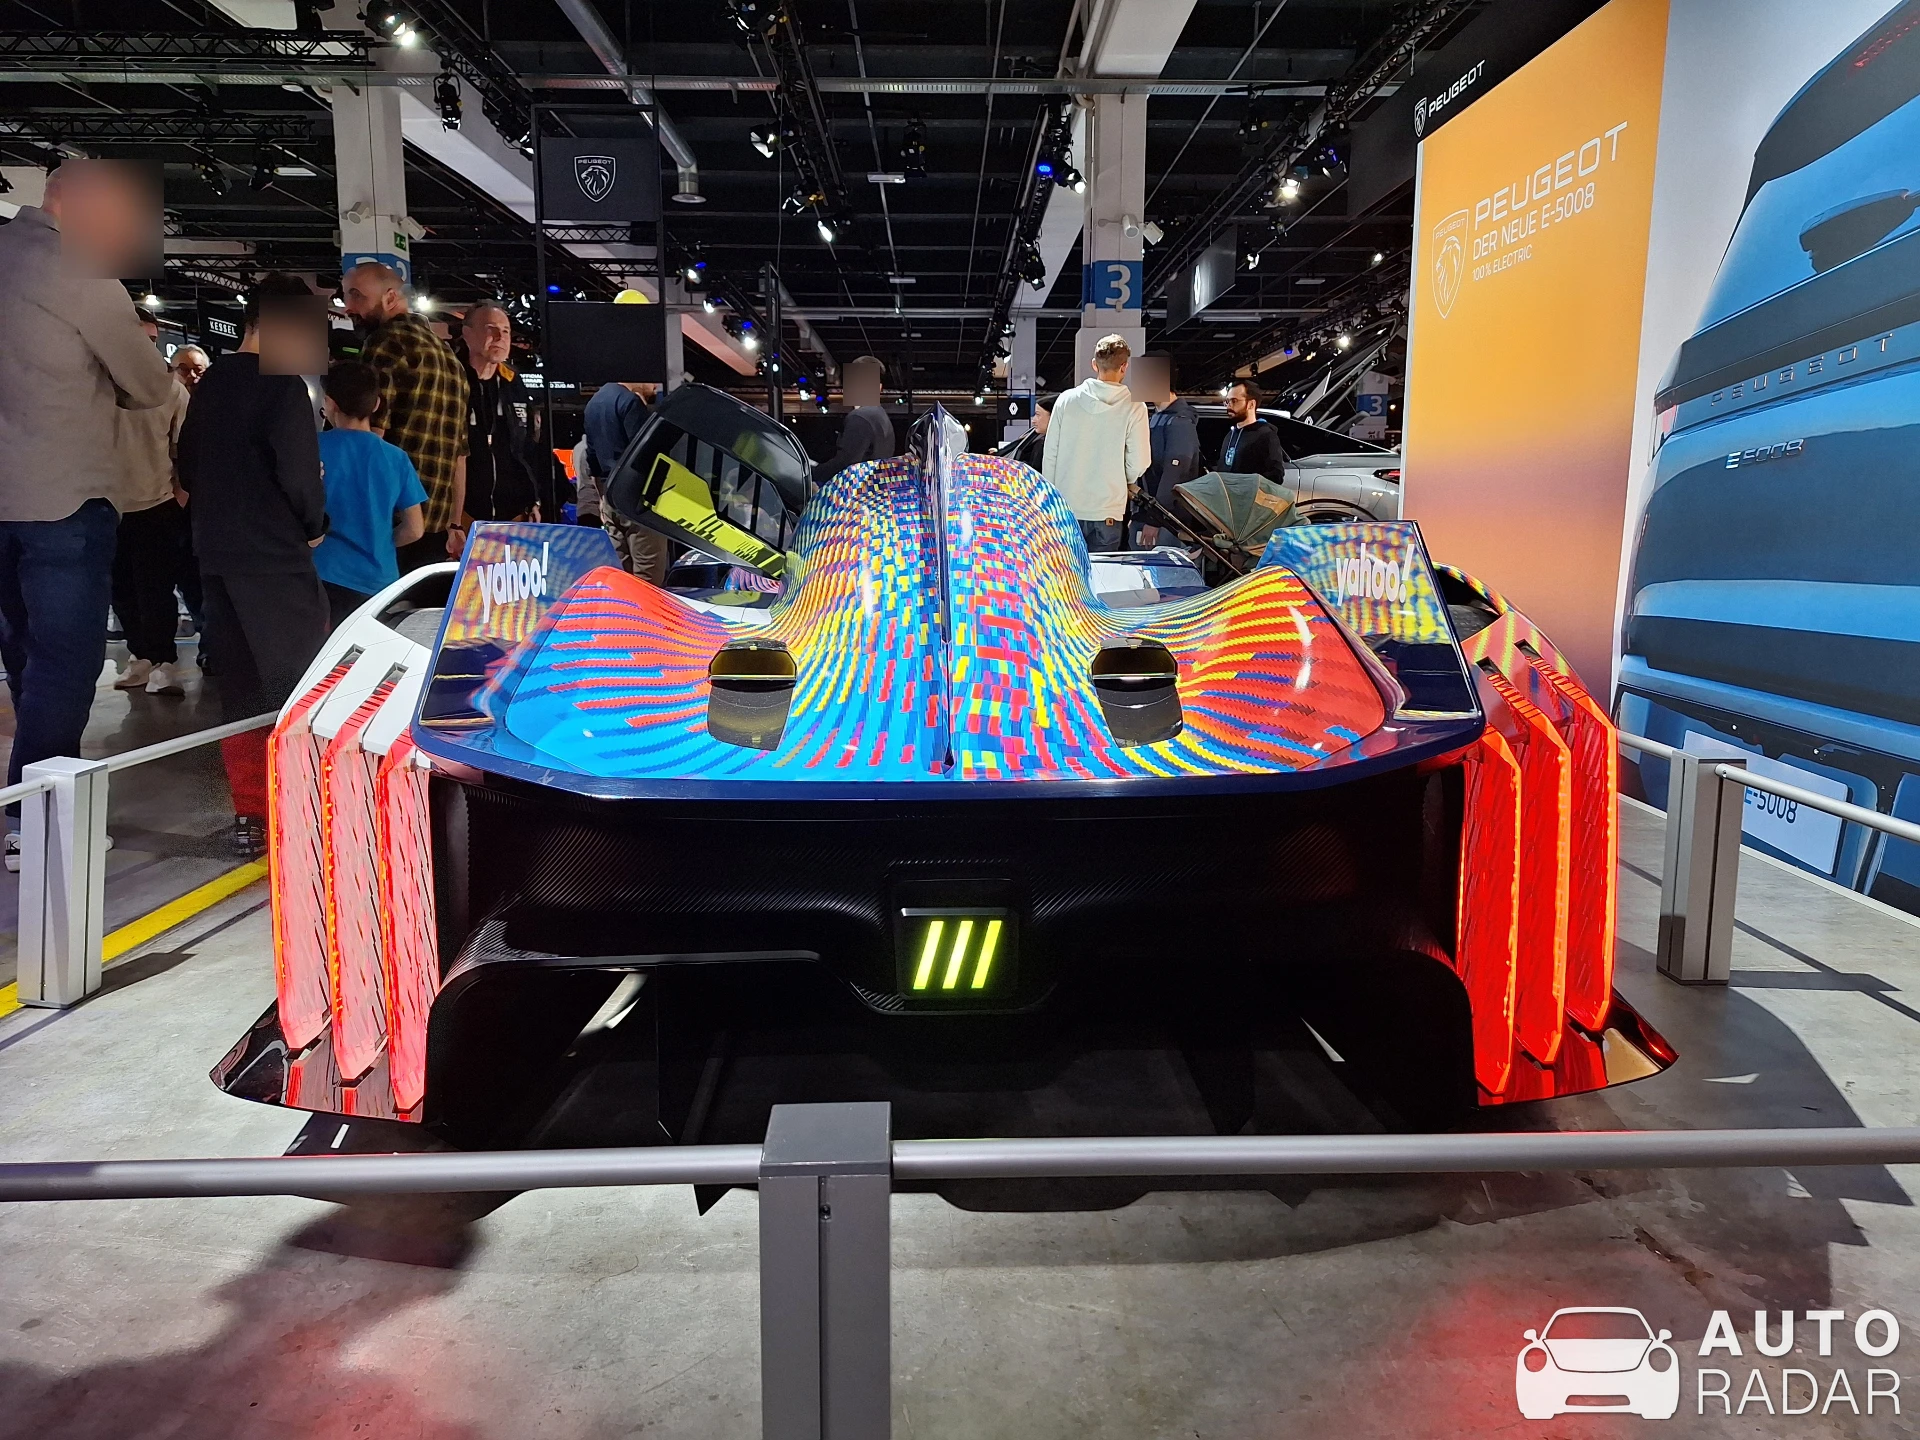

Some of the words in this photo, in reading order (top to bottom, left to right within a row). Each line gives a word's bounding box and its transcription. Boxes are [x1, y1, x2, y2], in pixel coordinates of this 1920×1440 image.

[1428, 60, 1485, 118] PEUGEOT
[1474, 121, 1628, 231] PEUGEOT
[1435, 217, 1466, 240] PEUGEOT
[1473, 230, 1497, 261] DER
[1501, 209, 1537, 247] NEUE
[1541, 182, 1595, 229] E-5008
[1105, 264, 1131, 306] 3
[1472, 262, 1491, 282] 100%
[1493, 244, 1533, 273] ELECTRIC
[210, 320, 237, 335] KESSEL
[1711, 333, 1894, 407] PEUGEOT
[1369, 395, 1383, 415] 3
[476, 541, 549, 623] yahoo!
[1336, 543, 1415, 606] yahoo!
